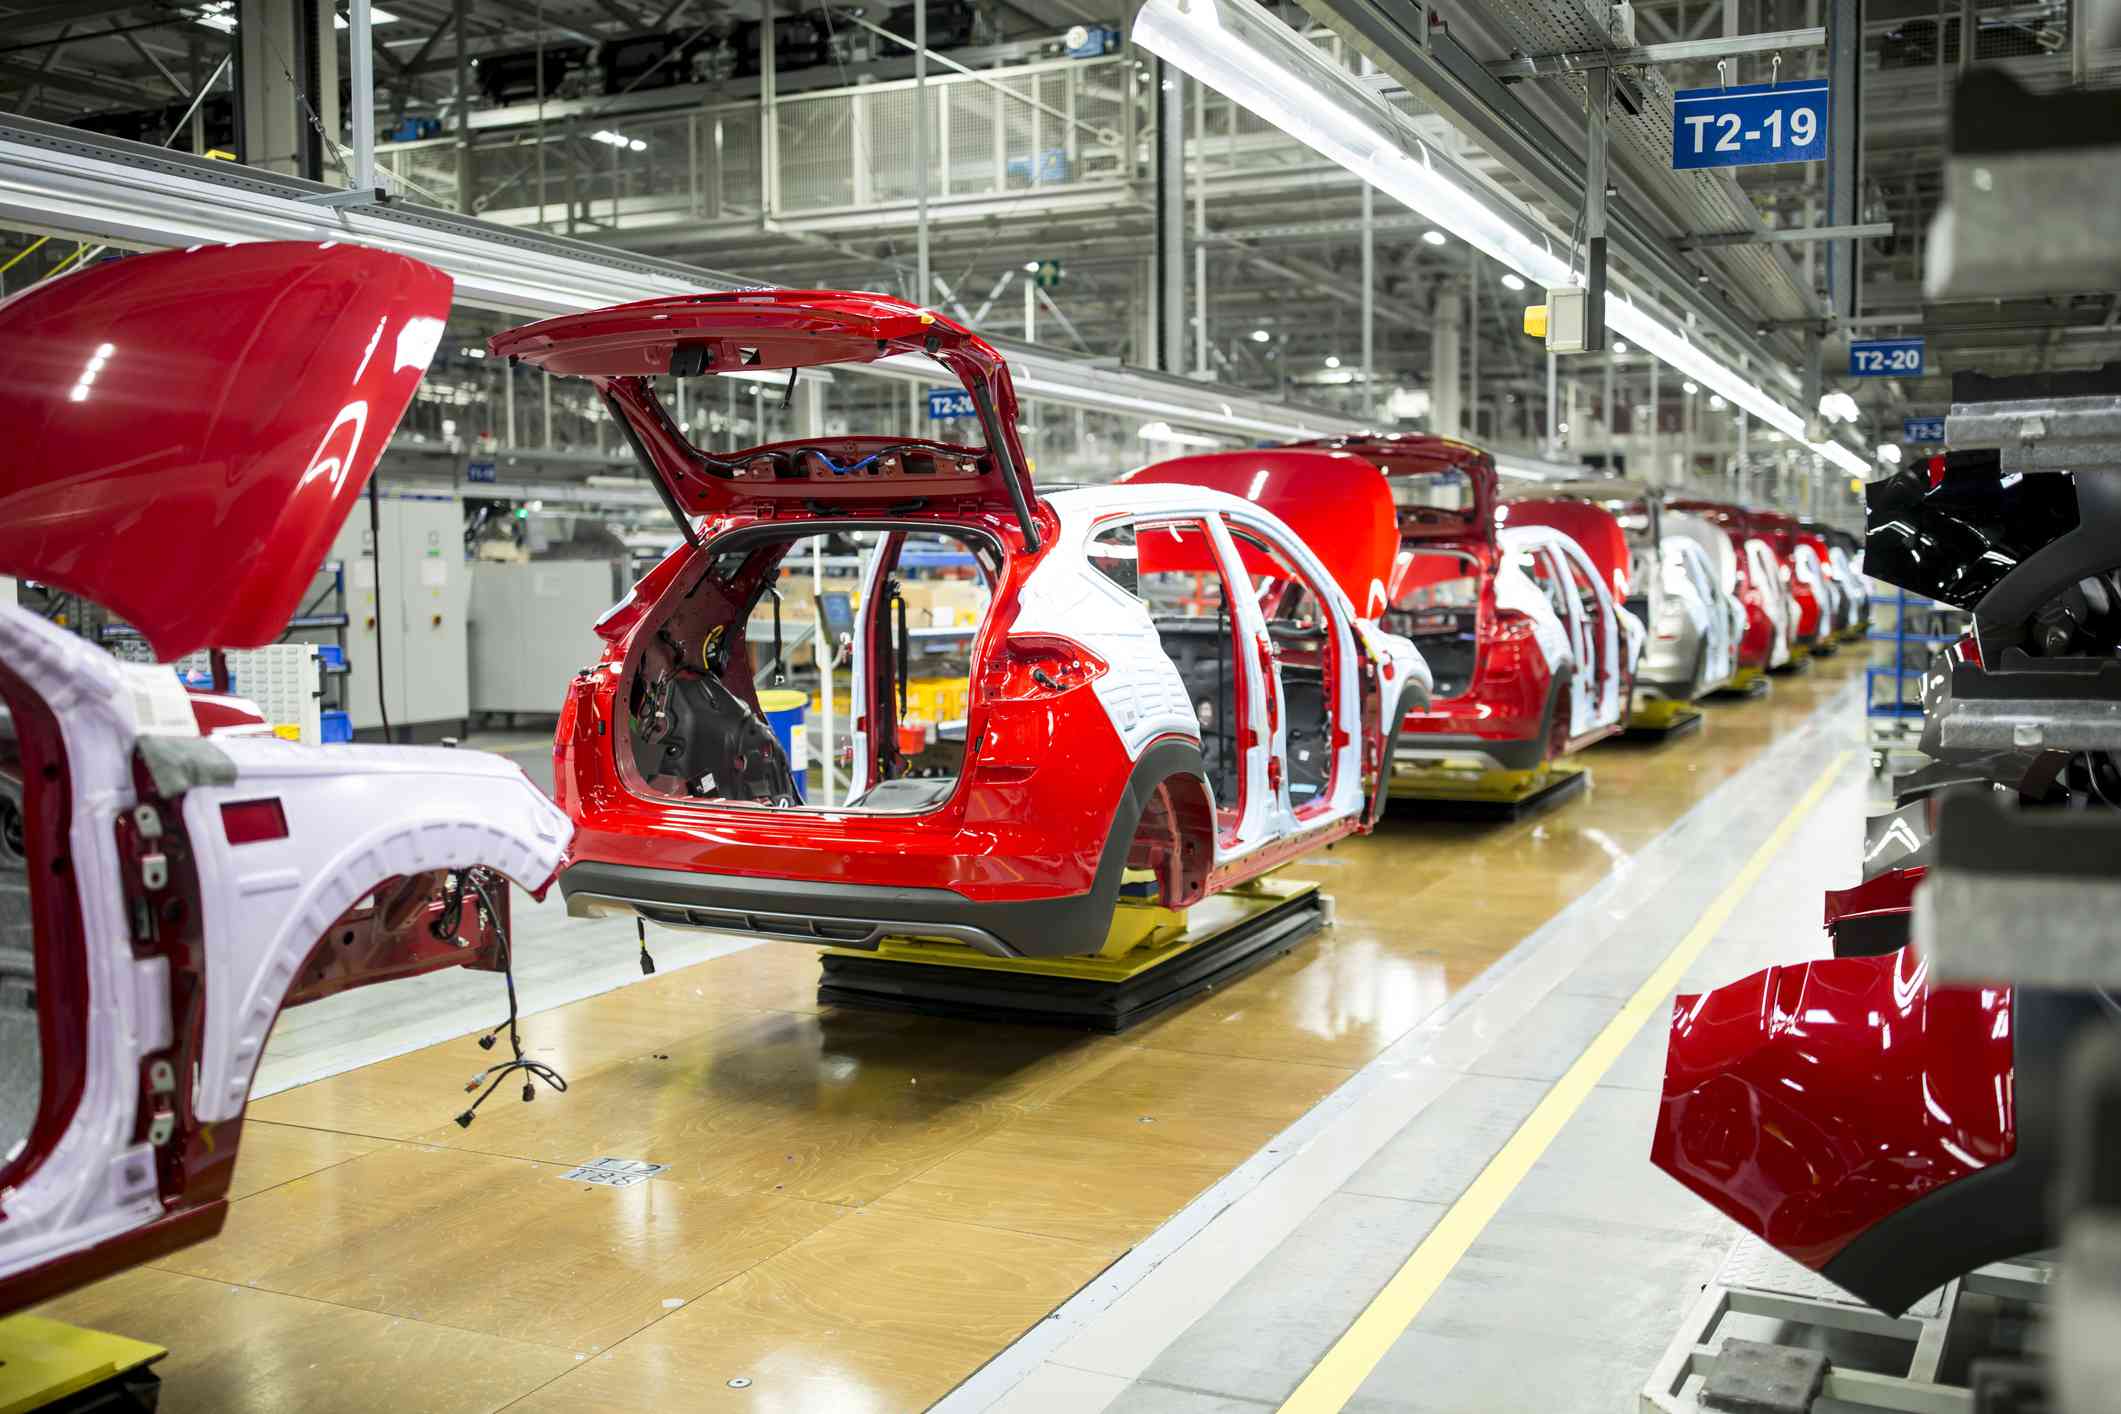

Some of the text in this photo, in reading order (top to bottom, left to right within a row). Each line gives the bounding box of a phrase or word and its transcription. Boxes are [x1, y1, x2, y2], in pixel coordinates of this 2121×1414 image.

[1684, 107, 1817, 153] T2-19
[1855, 350, 1919, 370] T2-20
[1908, 424, 1944, 439] T2-2
